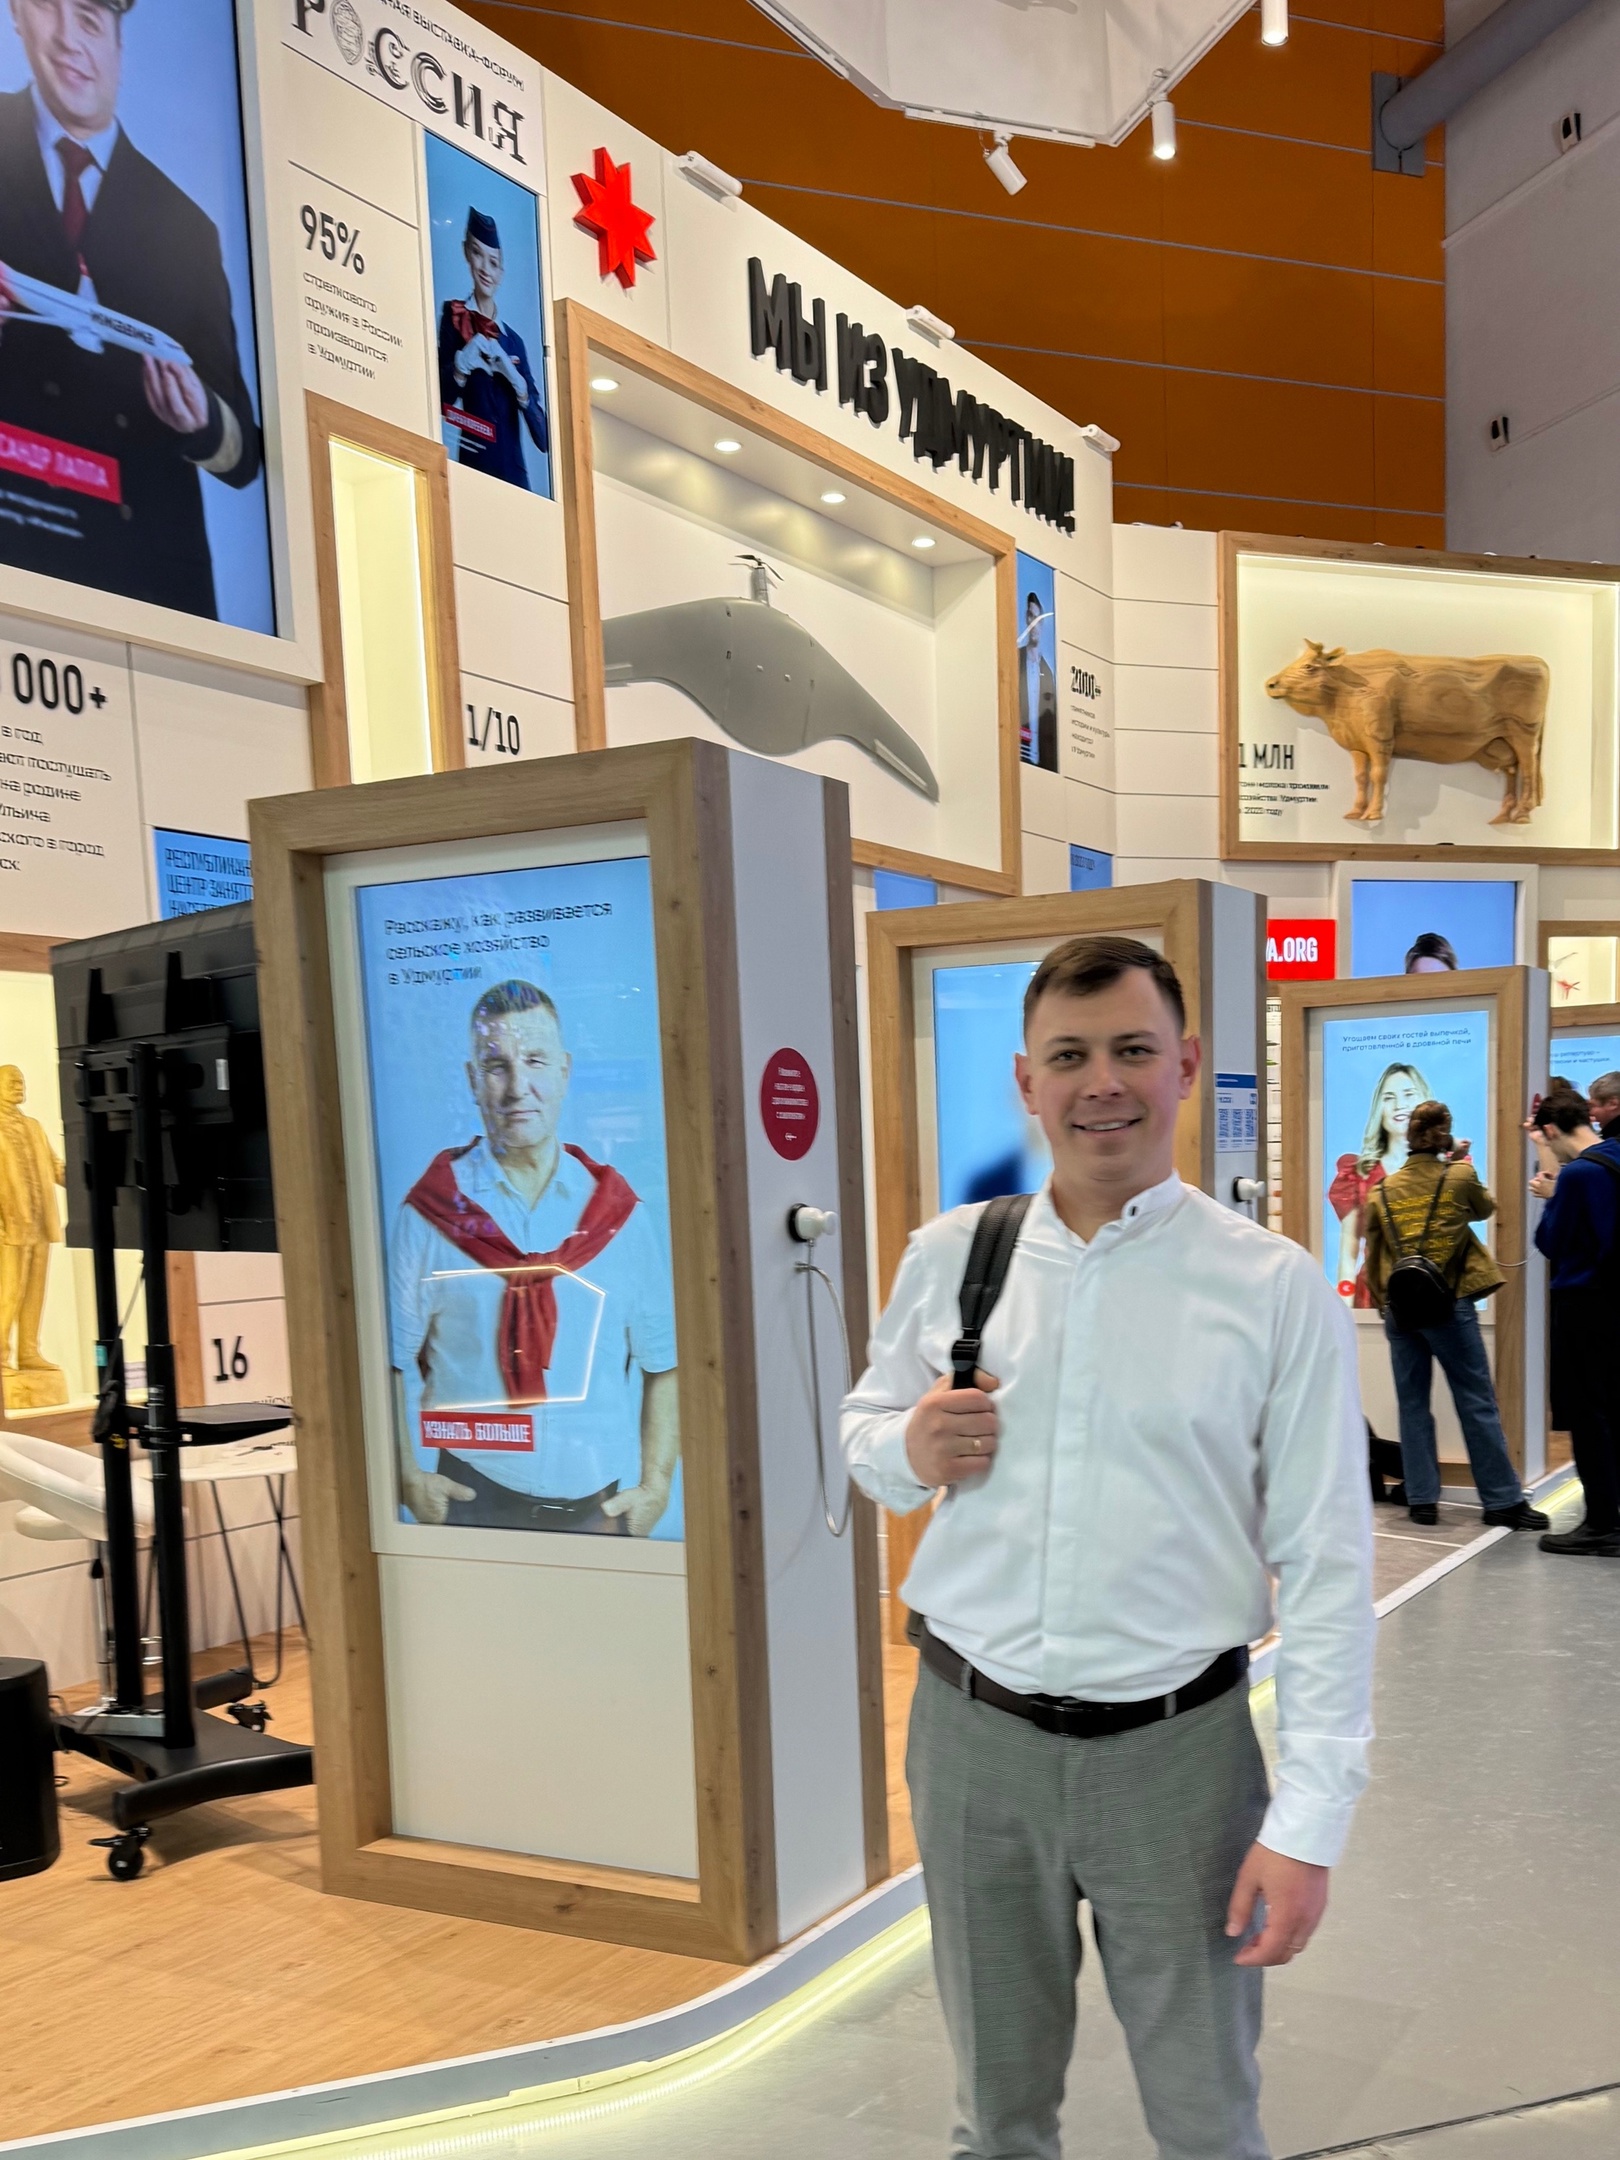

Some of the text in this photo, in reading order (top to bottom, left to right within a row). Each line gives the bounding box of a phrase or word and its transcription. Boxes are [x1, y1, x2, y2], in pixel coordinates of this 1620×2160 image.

[413, 9, 525, 92] ВЫСТАВКА-ФОРУМ
[291, 0, 527, 166] РОССИЯ
[300, 204, 365, 275] 95%
[303, 272, 377, 313] стрелкового
[748, 256, 827, 392] МЫ
[836, 312, 890, 424] ИЗ
[12, 652, 107, 715] 000+
[1070, 665, 1102, 700] 2000+
[2, 725, 44, 745] в год
[467, 703, 520, 756] 1/10
[27, 756, 112, 782] послушать
[1239, 743, 1294, 770] 1 МЛН
[23, 782, 82, 802] родине
[46, 838, 57, 850] в
[59, 839, 106, 858] город
[166, 873, 207, 897] ЦЕНТР
[503, 903, 613, 928] развивается
[386, 933, 550, 961] сельское хозяйство
[388, 972, 400, 985] в
[1342, 1034, 1378, 1042] Угощаем
[1402, 1030, 1429, 1039] гостей
[212, 1335, 248, 1382] 16
[423, 1420, 532, 1443] УЗНАТЬ БОЛЬШЕ
